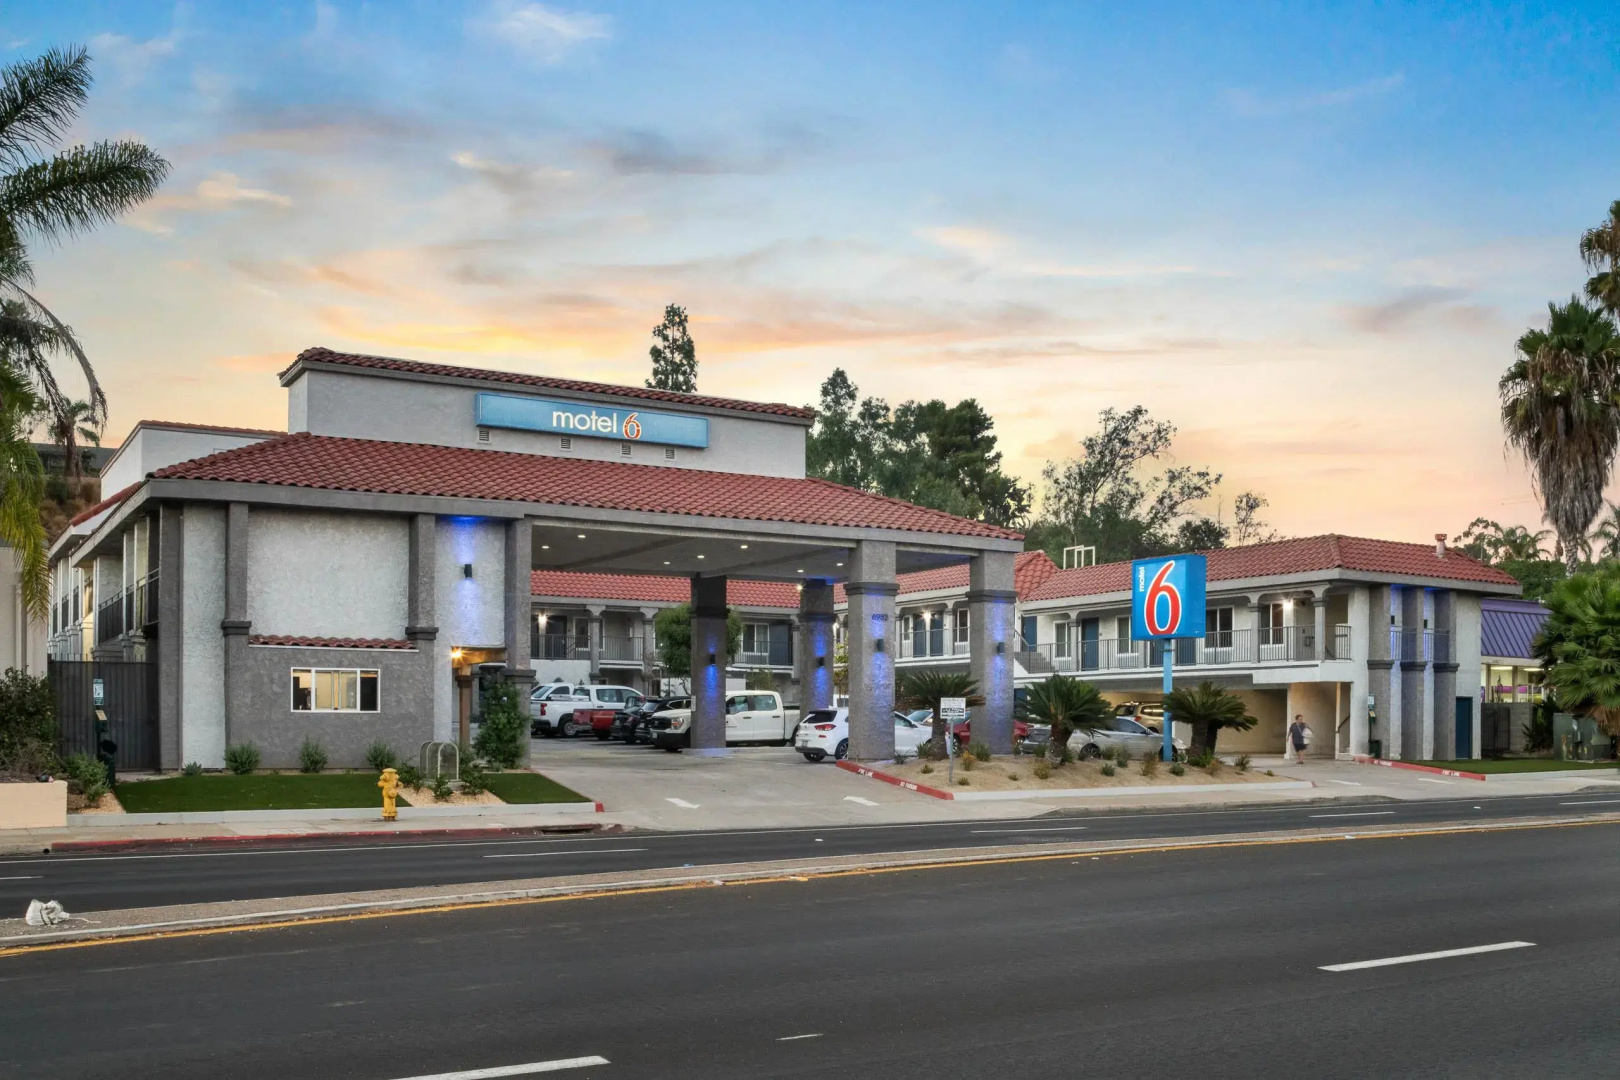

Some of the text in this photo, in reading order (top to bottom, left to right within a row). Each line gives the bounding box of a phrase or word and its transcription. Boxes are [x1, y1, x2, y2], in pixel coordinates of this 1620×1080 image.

[553, 411, 641, 439] motel 6
[1144, 560, 1182, 636] 6
